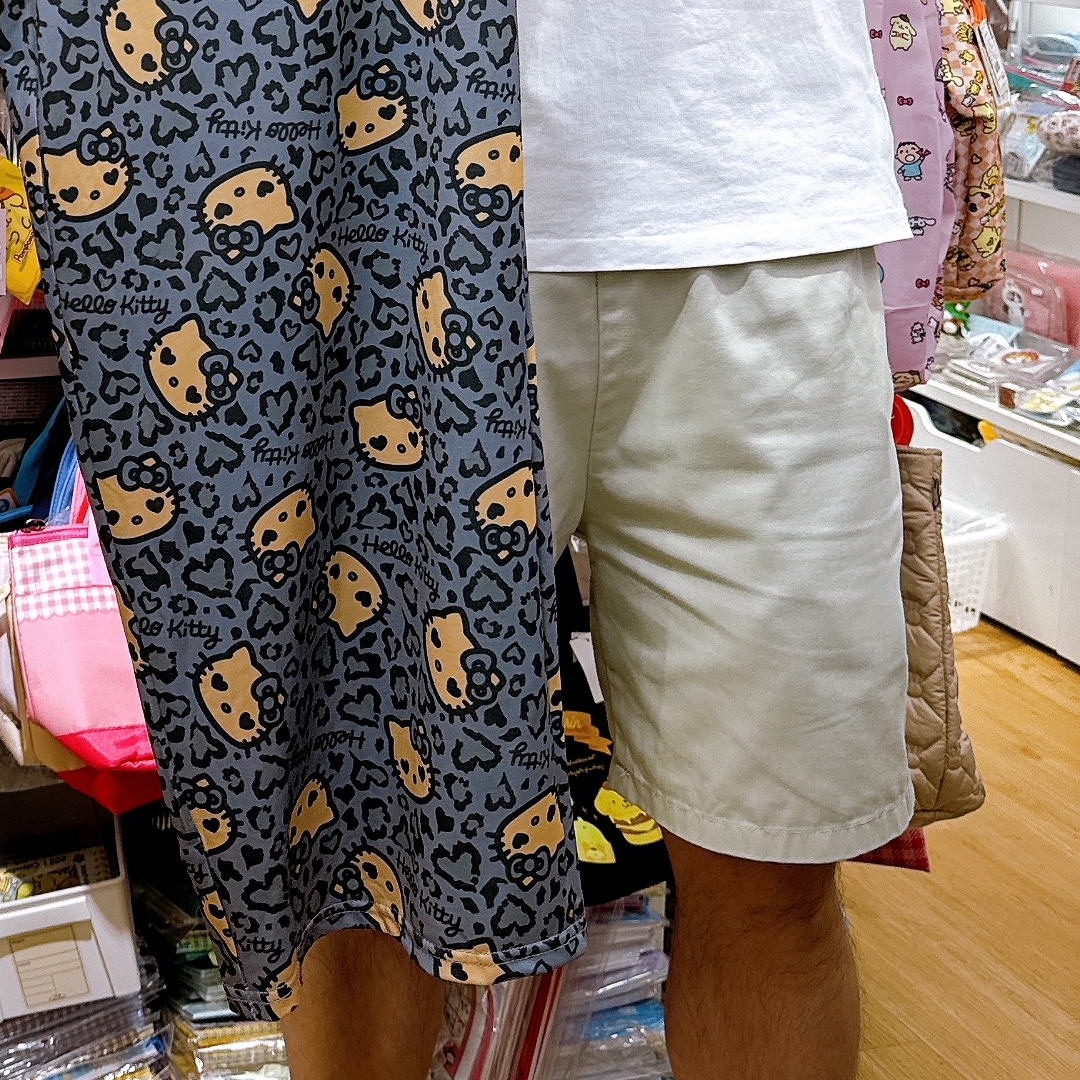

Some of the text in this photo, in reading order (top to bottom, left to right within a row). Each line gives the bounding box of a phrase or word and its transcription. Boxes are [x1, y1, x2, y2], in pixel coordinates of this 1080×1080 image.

[466, 68, 519, 103] Kitty
[205, 107, 322, 142] Hello Kitty
[336, 224, 430, 266] Hello Kitty
[120, 294, 173, 322] Kitty
[484, 408, 528, 441] Kitty
[252, 437, 301, 467] Kitty
[362, 532, 415, 572] Hello
[168, 617, 224, 651] Kitty
[313, 729, 367, 753] Hello
[509, 739, 555, 770] Kitty
[233, 935, 284, 965] Kitty
